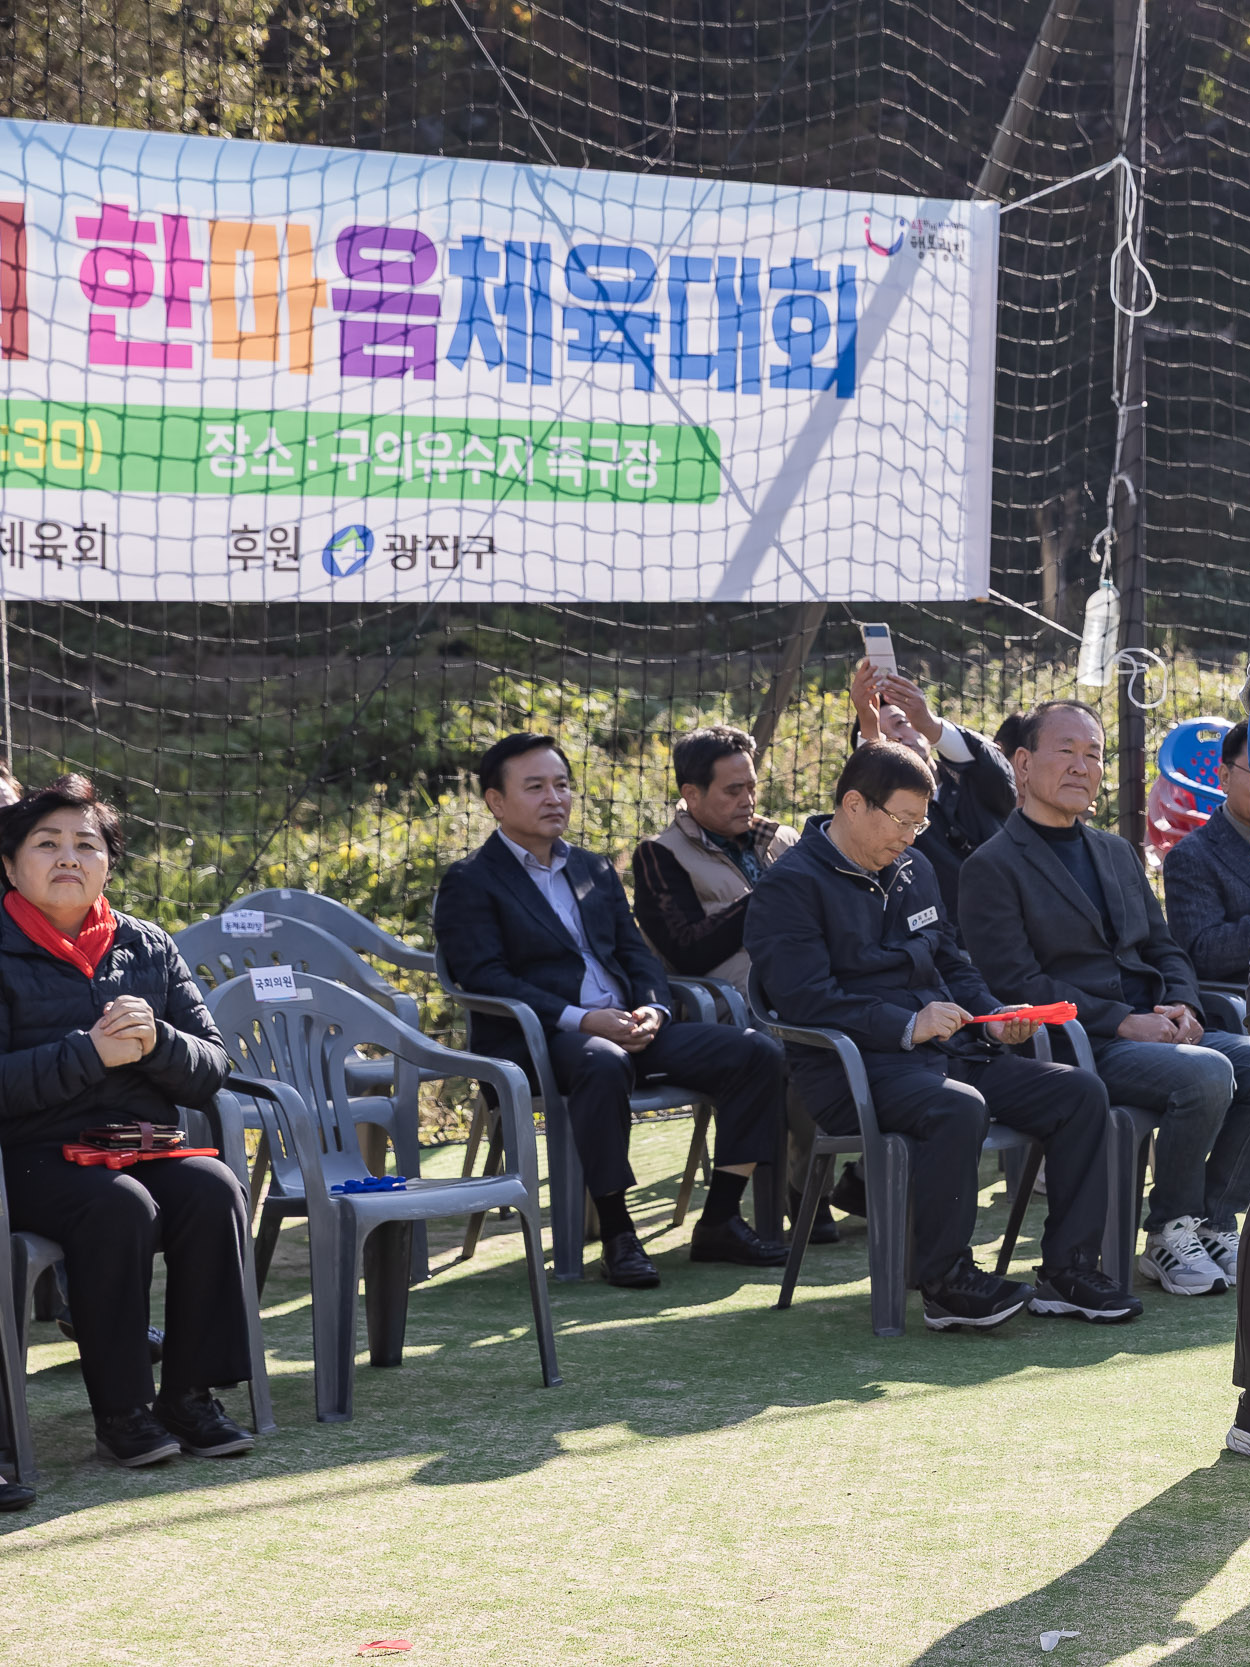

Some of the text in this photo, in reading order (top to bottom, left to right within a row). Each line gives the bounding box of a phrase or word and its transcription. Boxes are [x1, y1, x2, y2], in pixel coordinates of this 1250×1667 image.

[75, 203, 858, 399] 한마음체육대회
[205, 424, 295, 478] 장소
[330, 429, 534, 486] 구의유수지
[546, 436, 662, 488] 족구장
[228, 523, 300, 572] 후원
[383, 534, 497, 571] 광진구
[255, 975, 293, 990] 국회의원
